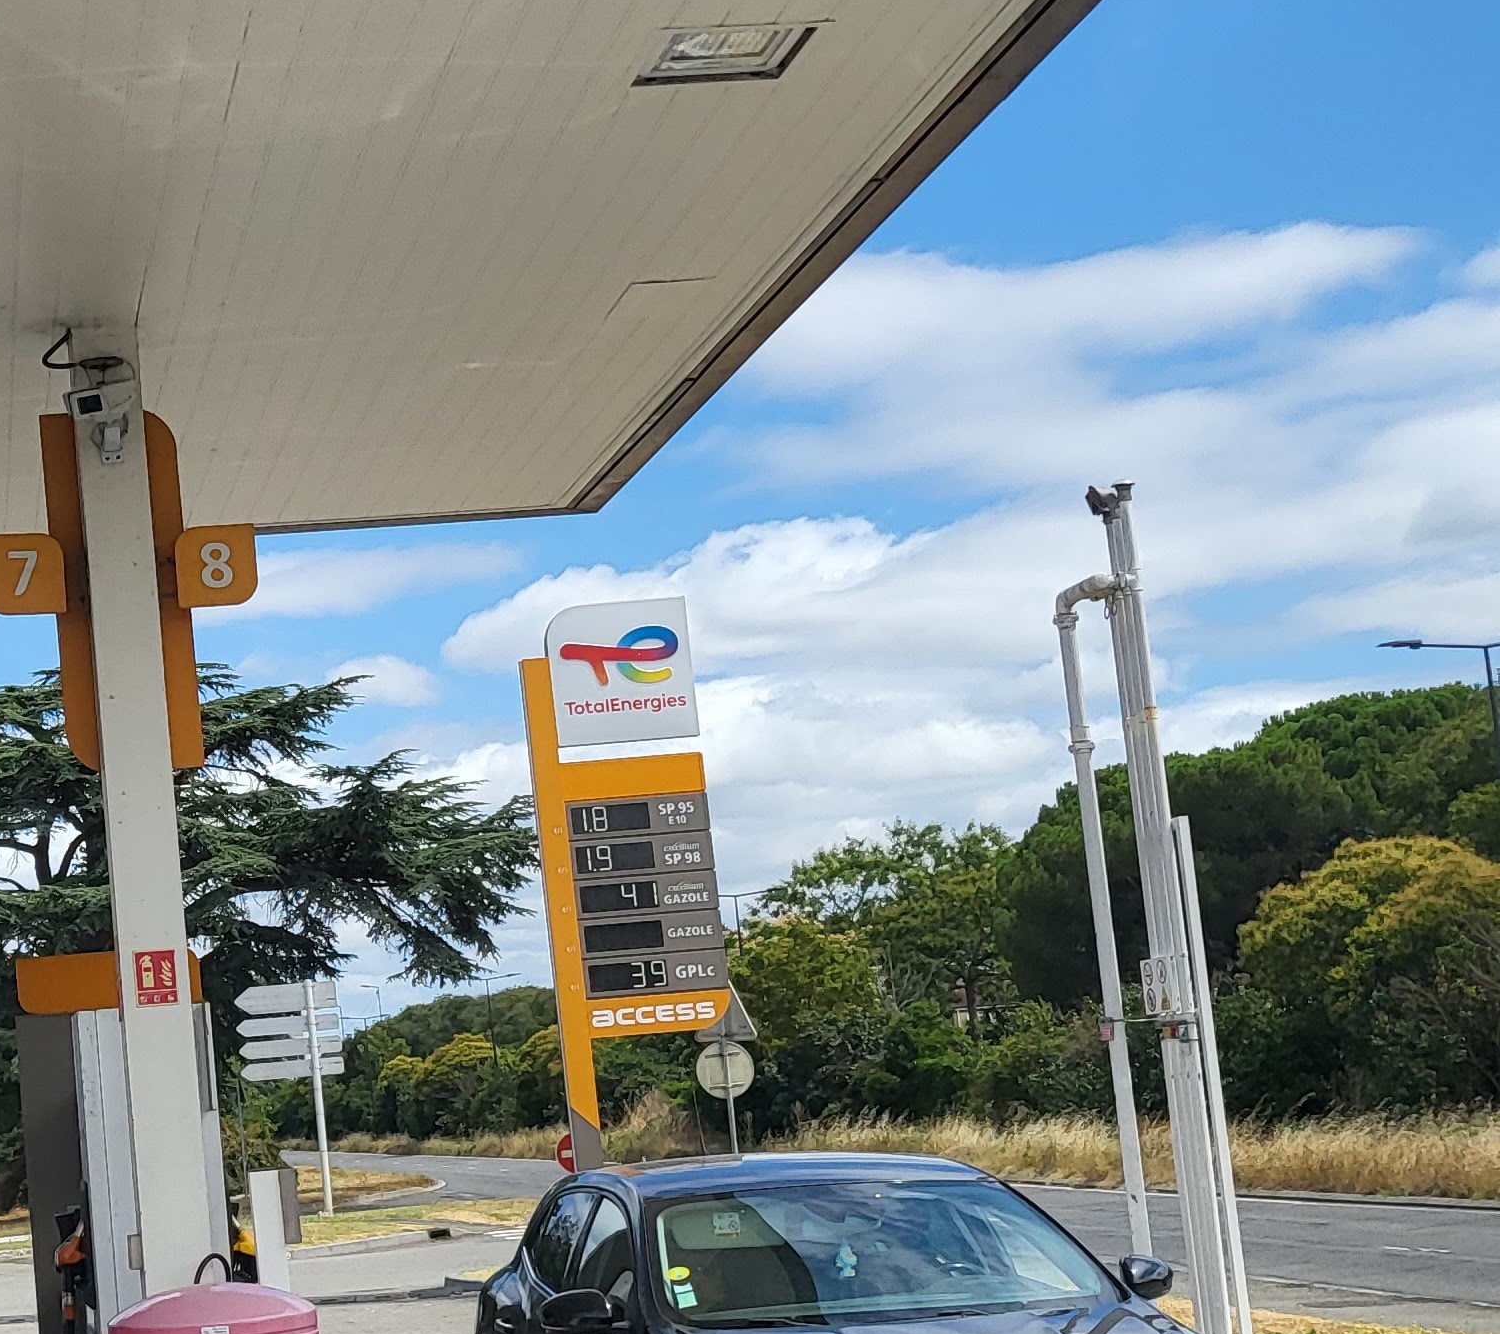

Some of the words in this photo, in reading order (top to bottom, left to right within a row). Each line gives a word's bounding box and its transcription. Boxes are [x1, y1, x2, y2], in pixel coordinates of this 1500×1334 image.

[7, 550, 38, 596] 7
[200, 542, 234, 589] 8
[564, 693, 687, 716] TotalEnergies
[657, 803, 675, 816] SP
[678, 801, 695, 814] 95
[668, 815, 688, 825] E10
[664, 853, 682, 865] SP
[684, 851, 702, 864] 98
[663, 891, 710, 905] GAZOLE
[667, 924, 714, 938] GAZOLE
[631, 960, 667, 988] 39
[675, 964, 716, 979] GPLc
